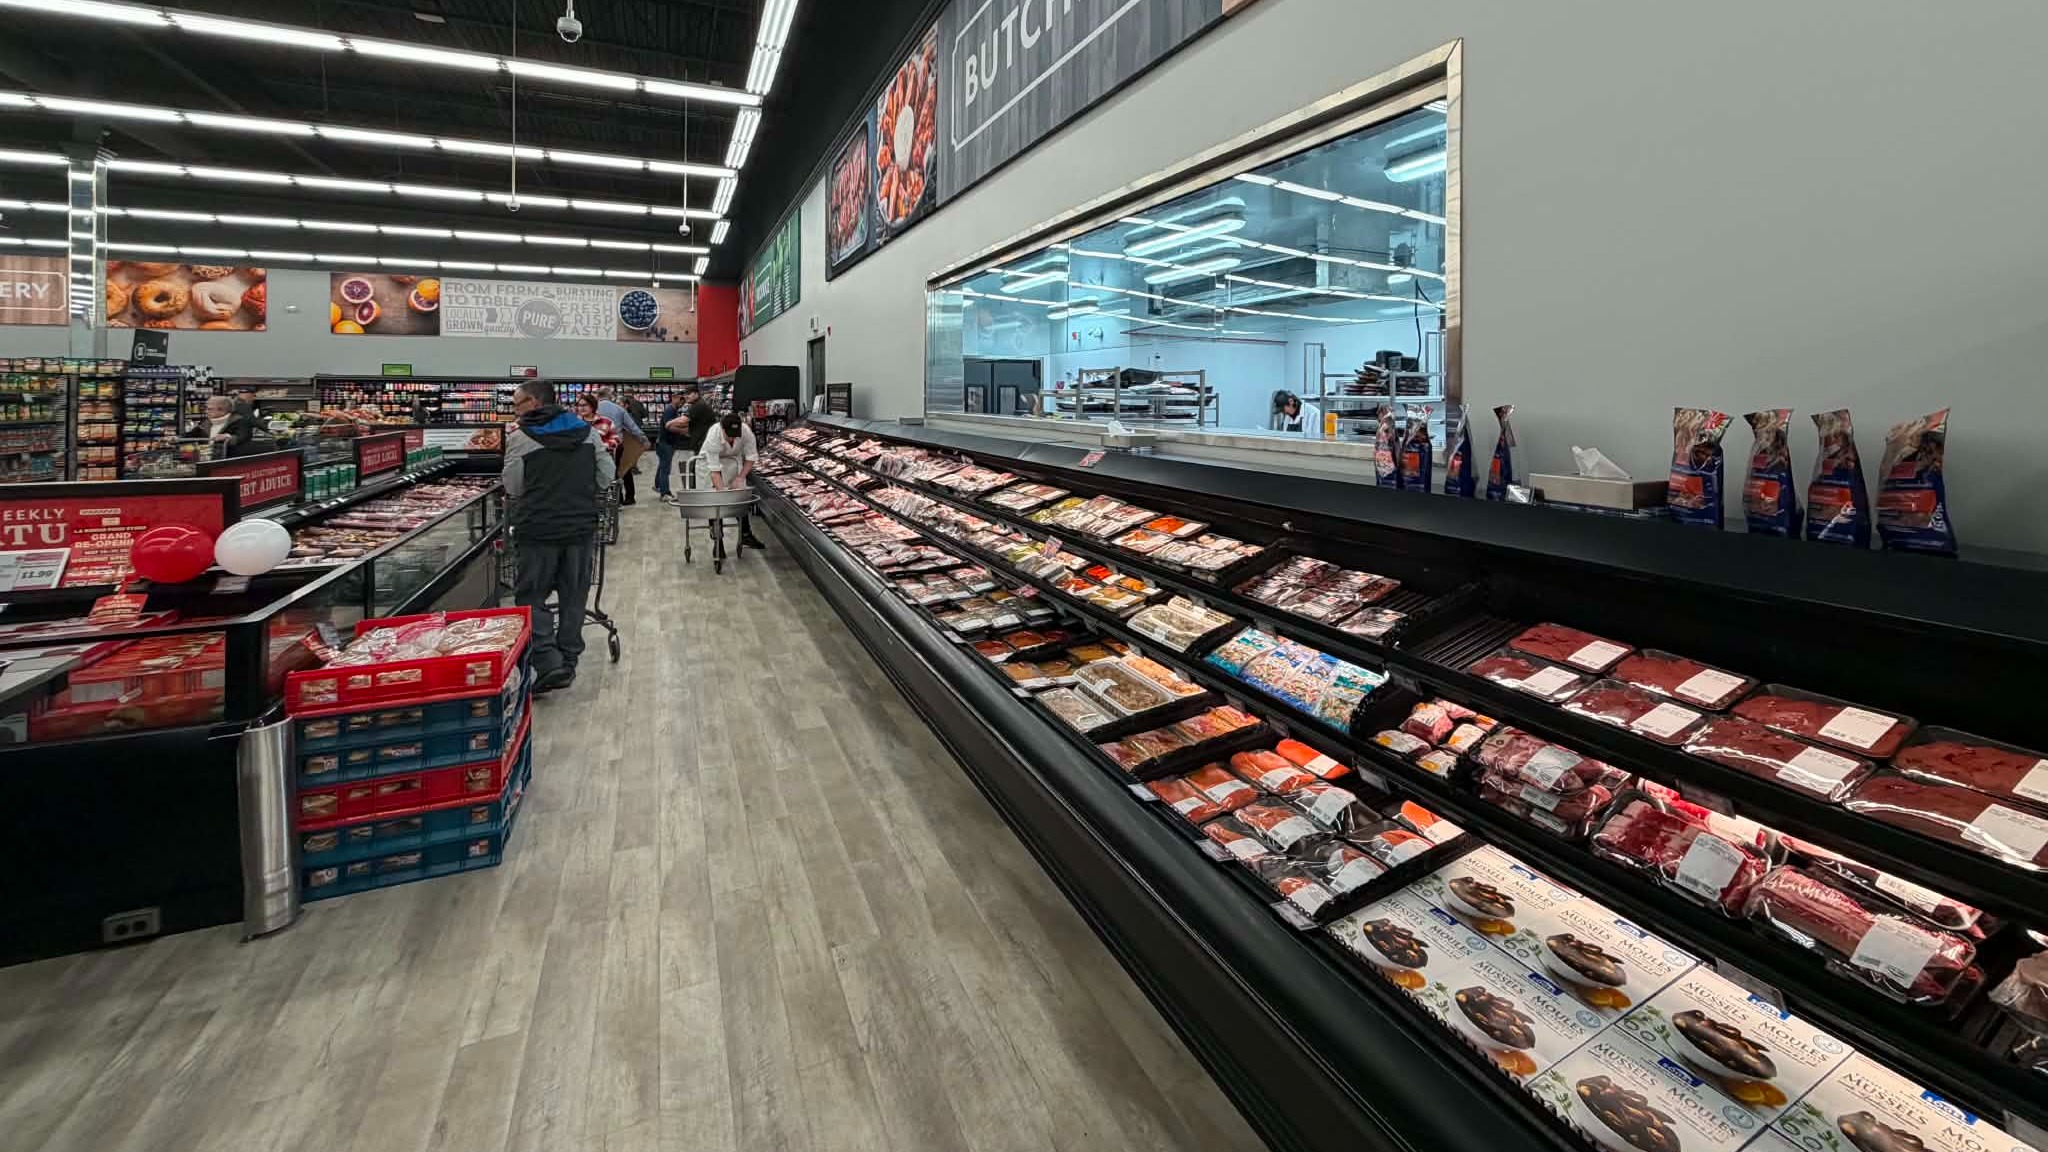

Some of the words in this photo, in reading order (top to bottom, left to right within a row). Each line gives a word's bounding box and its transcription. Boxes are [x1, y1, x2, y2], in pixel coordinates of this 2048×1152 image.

[0, 281, 51, 299] ERY
[445, 283, 490, 294] FROM
[556, 287, 615, 297] BURSTING
[445, 293, 468, 305] TO
[472, 295, 521, 307] TABLE
[446, 308, 483, 320] LOCALLY
[560, 302, 613, 316] FRESH
[447, 320, 484, 331] GROWN
[522, 309, 556, 329] PURE
[560, 313, 613, 326] CRISP
[560, 325, 613, 337] TASTY
[260, 474, 293, 493] ADVICE
[3, 508, 65, 521] EEKLY
[0, 523, 69, 546] TU
[1561, 909, 1611, 940] MUSSELS
[1619, 939, 1673, 973] MOULES
[1475, 961, 1527, 995] MUSSELS
[1532, 995, 1586, 1036] MOULES
[1685, 981, 1750, 1021] MUSSELS
[1758, 1021, 1831, 1062] MOULES
[1593, 1043, 1658, 1086] MUSSELS
[1667, 1086, 1740, 1137] MOULES
[1842, 1072, 1929, 1126] MUSSELS
